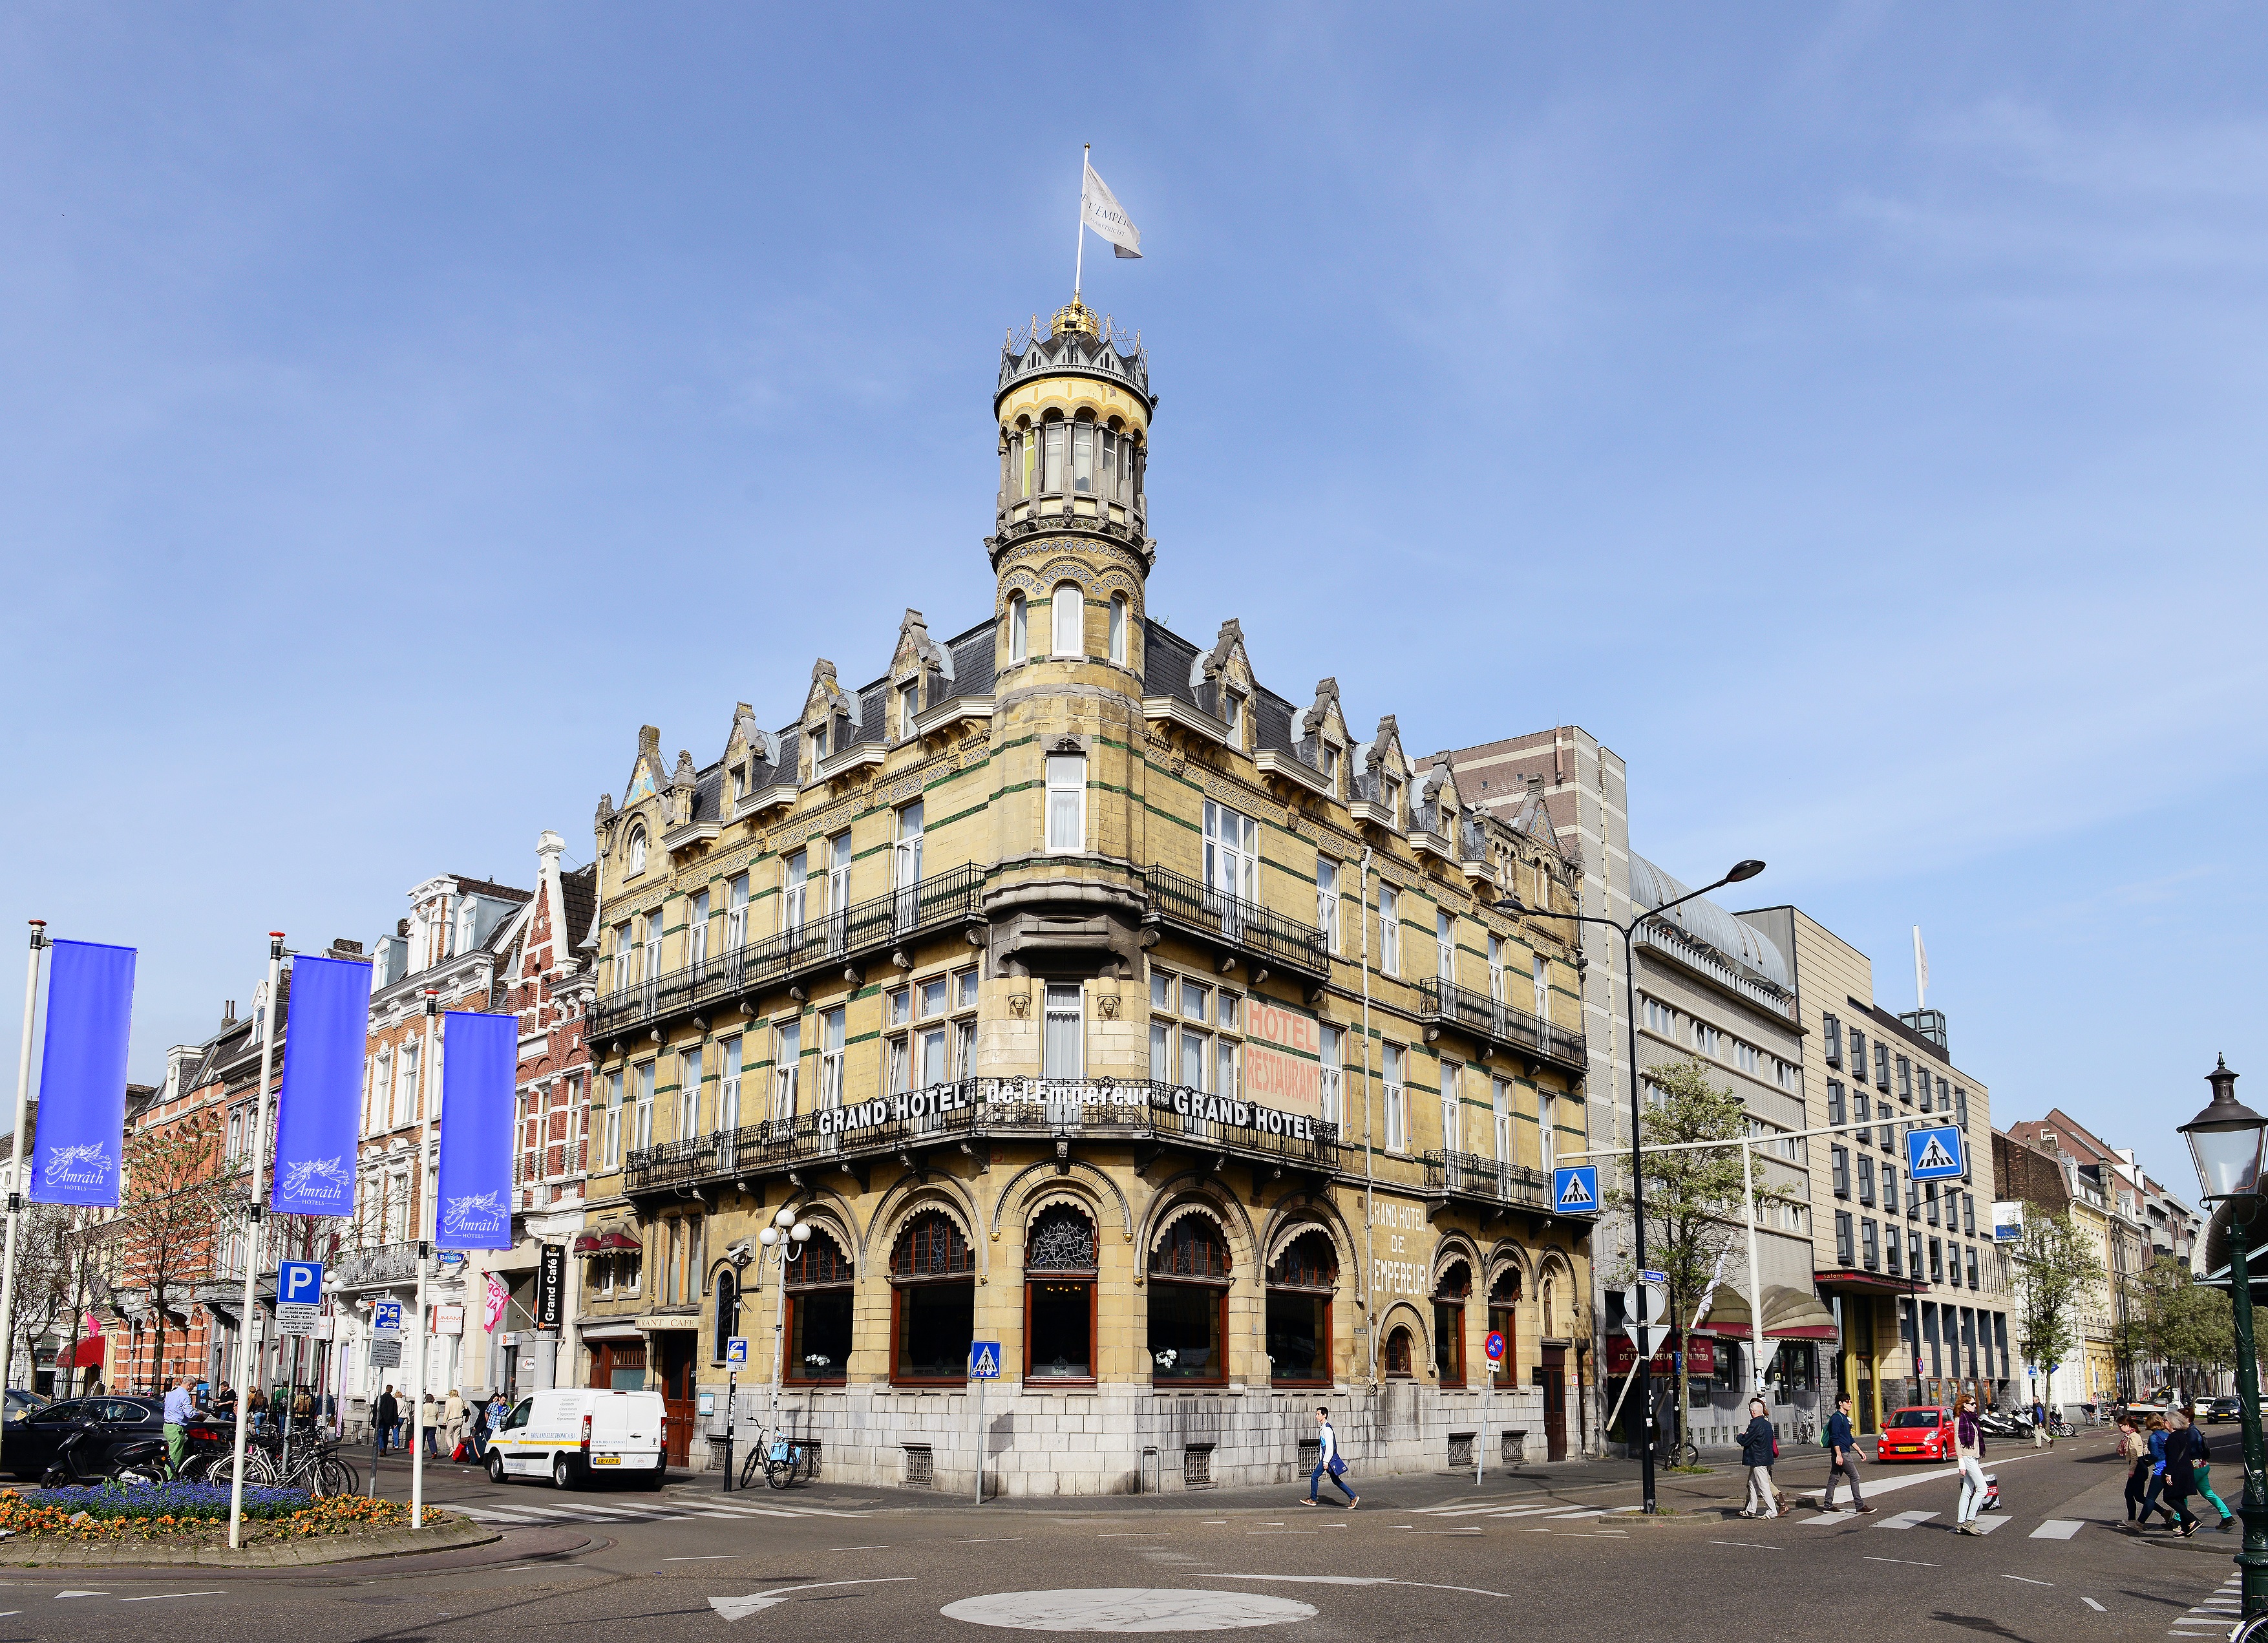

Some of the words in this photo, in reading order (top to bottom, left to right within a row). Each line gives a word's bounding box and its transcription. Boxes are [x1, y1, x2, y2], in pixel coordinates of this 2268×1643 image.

[1090, 217, 1126, 237] MAASTRICHT
[1249, 1001, 1317, 1053] HOTEL
[1247, 1047, 1320, 1105] RESTAURANT
[986, 1079, 1015, 1105] de
[1023, 1080, 1151, 1110] l'Empereur
[818, 1101, 887, 1136] GRAND
[896, 1084, 966, 1121] HOTEL
[1174, 1089, 1247, 1127] GRAND
[1255, 1107, 1315, 1141] HOTEL
[46, 1167, 103, 1185] Amrâth
[284, 1182, 341, 1199] Amrâth
[445, 1216, 500, 1234] Amrâth
[1399, 1205, 1426, 1232] HOTEL
[1391, 1235, 1404, 1253] DE
[288, 1266, 313, 1298] P
[547, 1258, 558, 1284] Café
[1372, 1259, 1426, 1295] 'EMPEREUR
[377, 1306, 388, 1320] P
[545, 1287, 556, 1321] Grand
